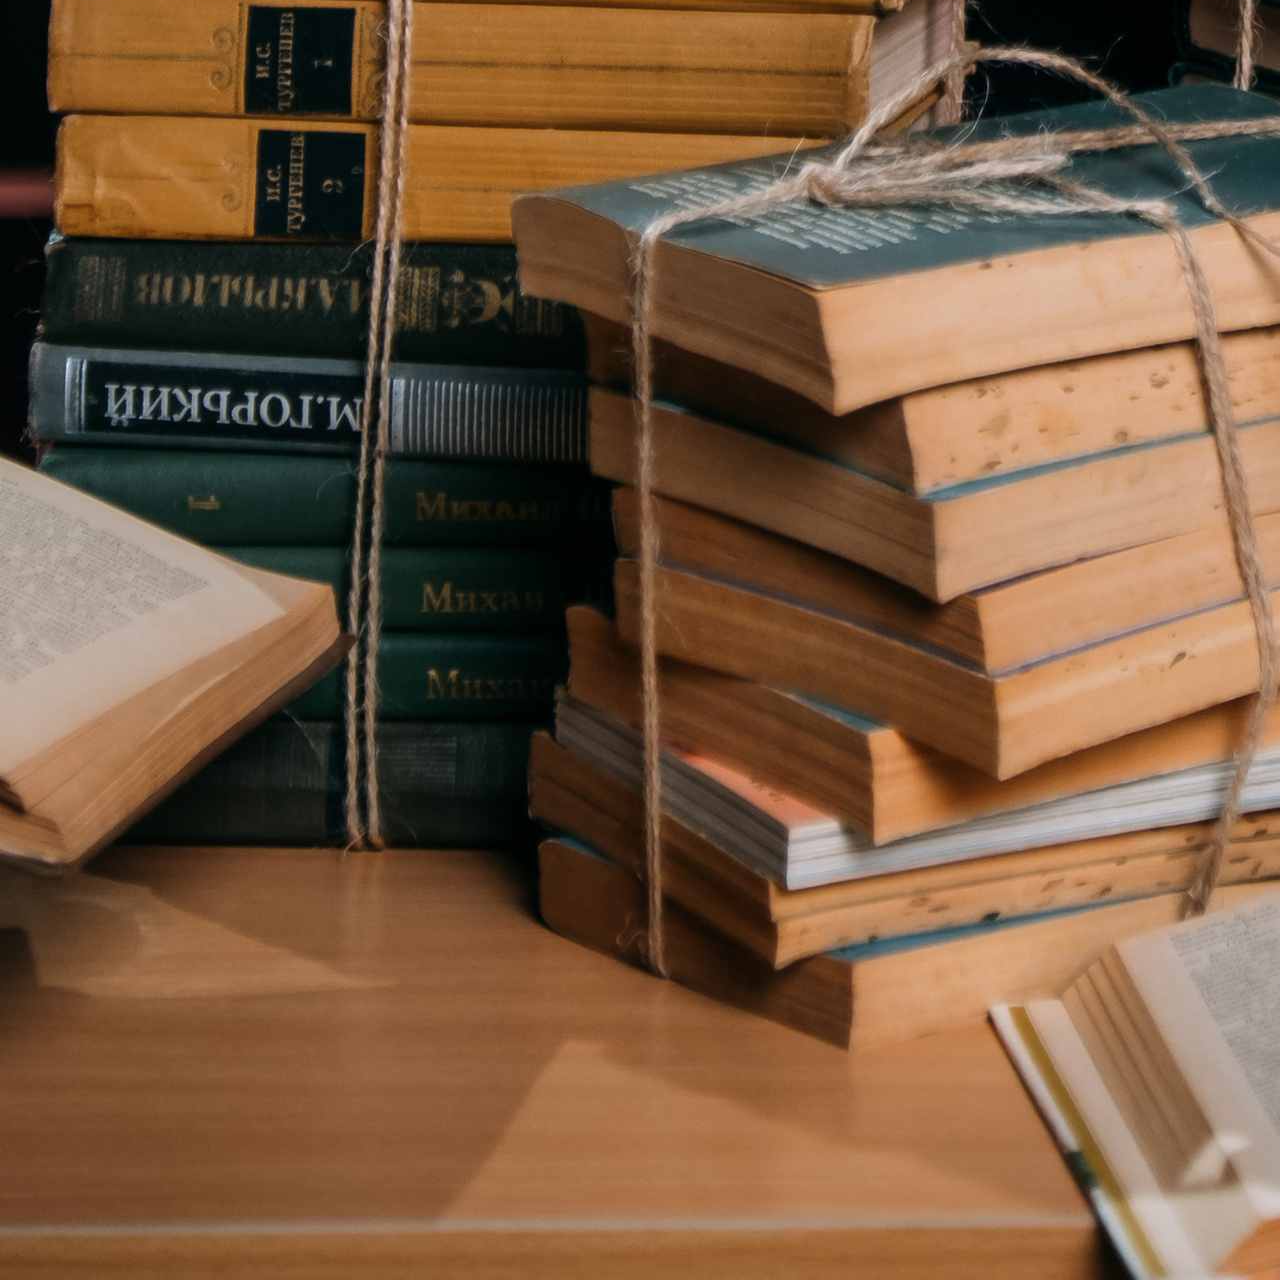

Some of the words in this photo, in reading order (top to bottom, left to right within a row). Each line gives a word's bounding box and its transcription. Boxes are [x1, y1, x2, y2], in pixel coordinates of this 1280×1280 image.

[104, 383, 364, 432] М.ГОРЬКИЙ
[415, 490, 561, 522] Михаил
[425, 667, 557, 699] Михаи
